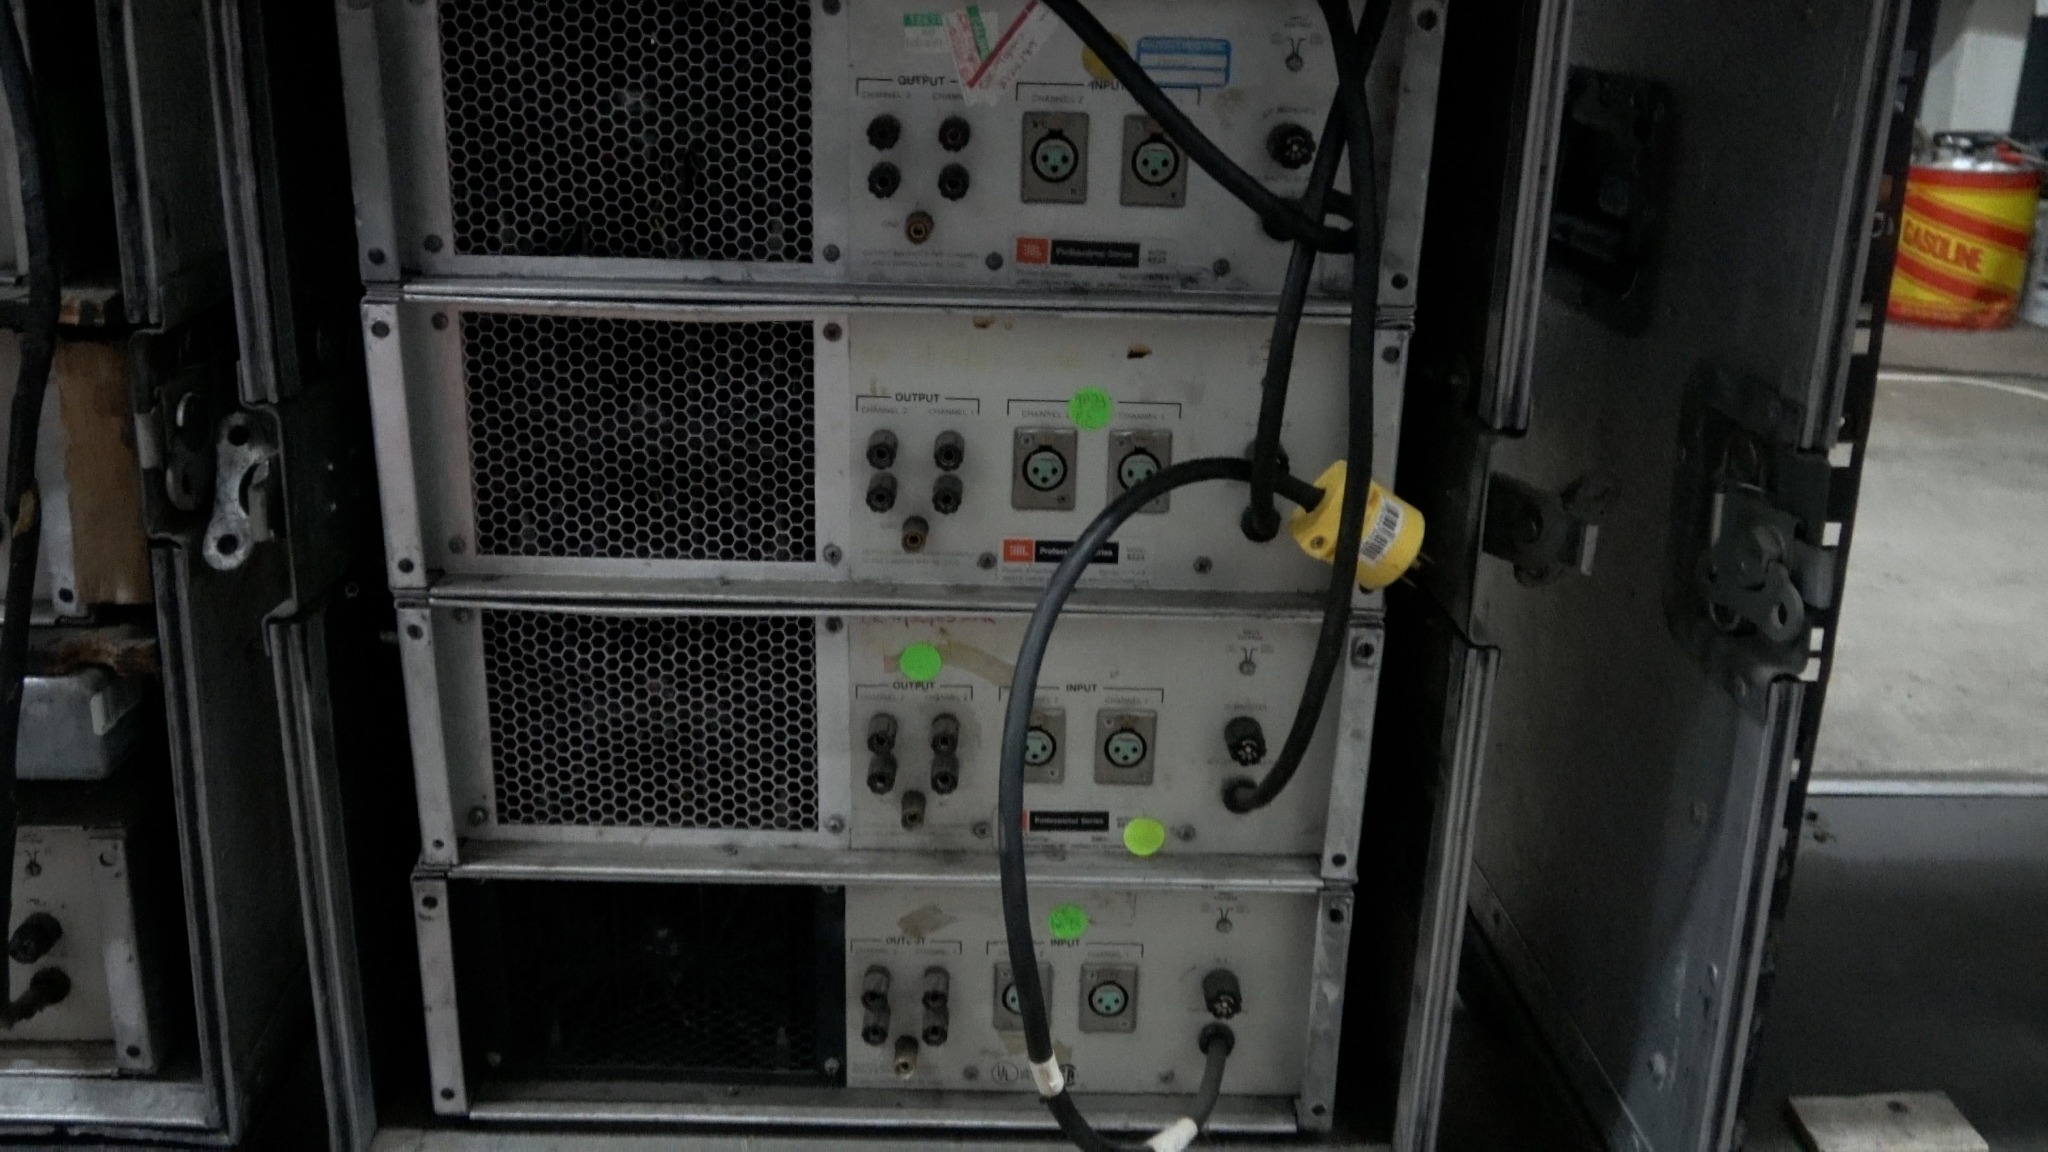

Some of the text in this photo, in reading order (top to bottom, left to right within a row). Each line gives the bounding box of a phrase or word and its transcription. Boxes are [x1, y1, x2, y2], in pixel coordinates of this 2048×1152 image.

[898, 75, 946, 86] OUTPUT
[932, 92, 963, 101] CHANN
[1022, 243, 1042, 256] JBL
[1903, 219, 1984, 274] GASOLINE
[895, 393, 940, 402] OUTPUT
[928, 408, 966, 416] CHANNEL
[1021, 410, 1061, 419] CHANNEL
[1009, 544, 1029, 556] JBL
[892, 681, 935, 690] OUTPUT
[1066, 683, 1097, 693] INPUT
